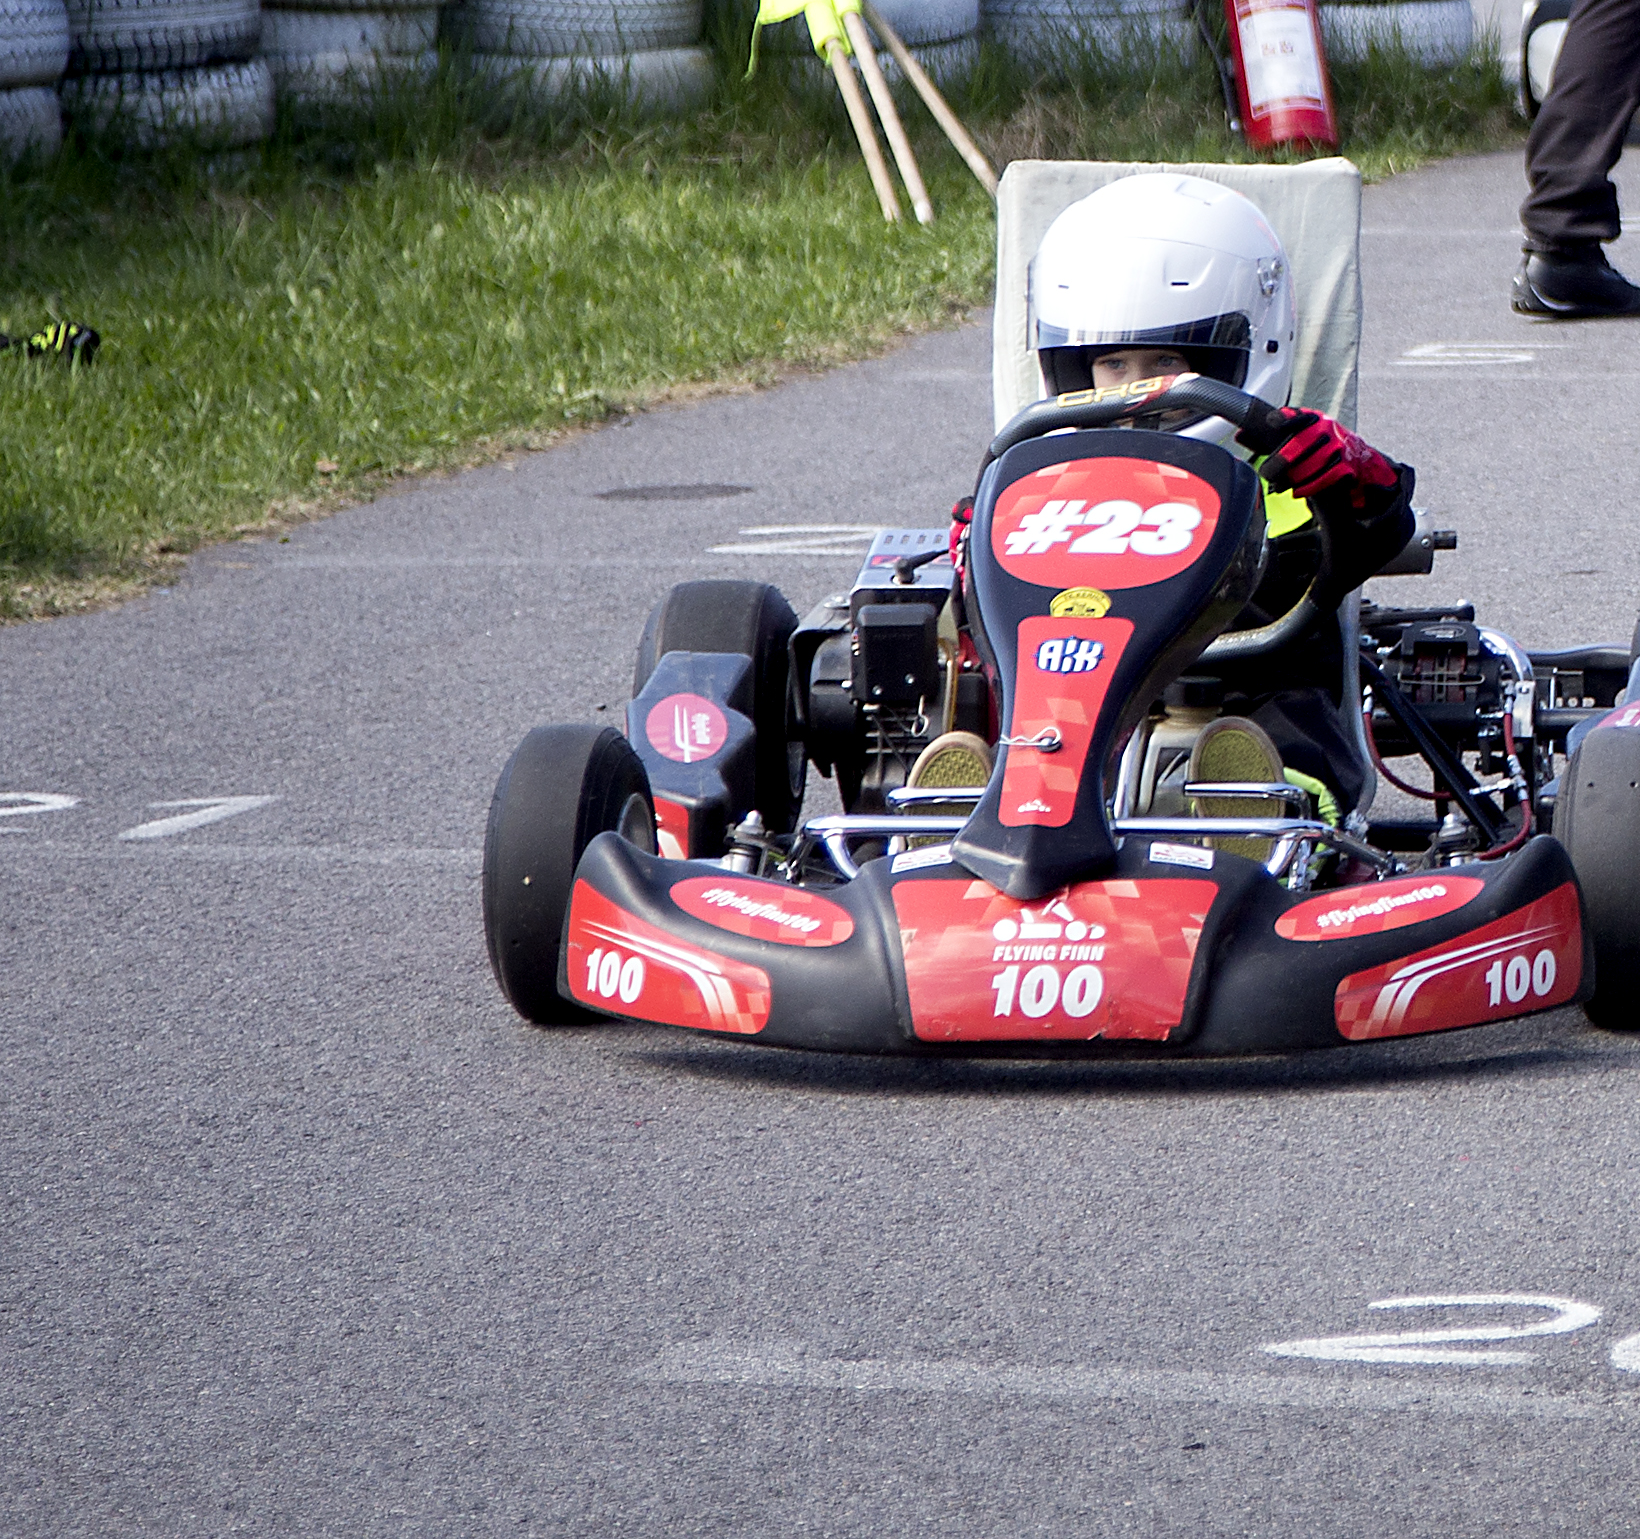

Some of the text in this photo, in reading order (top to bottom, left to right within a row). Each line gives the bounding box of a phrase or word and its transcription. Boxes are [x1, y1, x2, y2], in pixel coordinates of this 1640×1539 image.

[1004, 499, 1203, 555] #23
[586, 948, 644, 1004] 100
[992, 945, 1105, 962] FLYING FINN
[1484, 949, 1556, 1008] 100
[991, 964, 1104, 1019] 100
